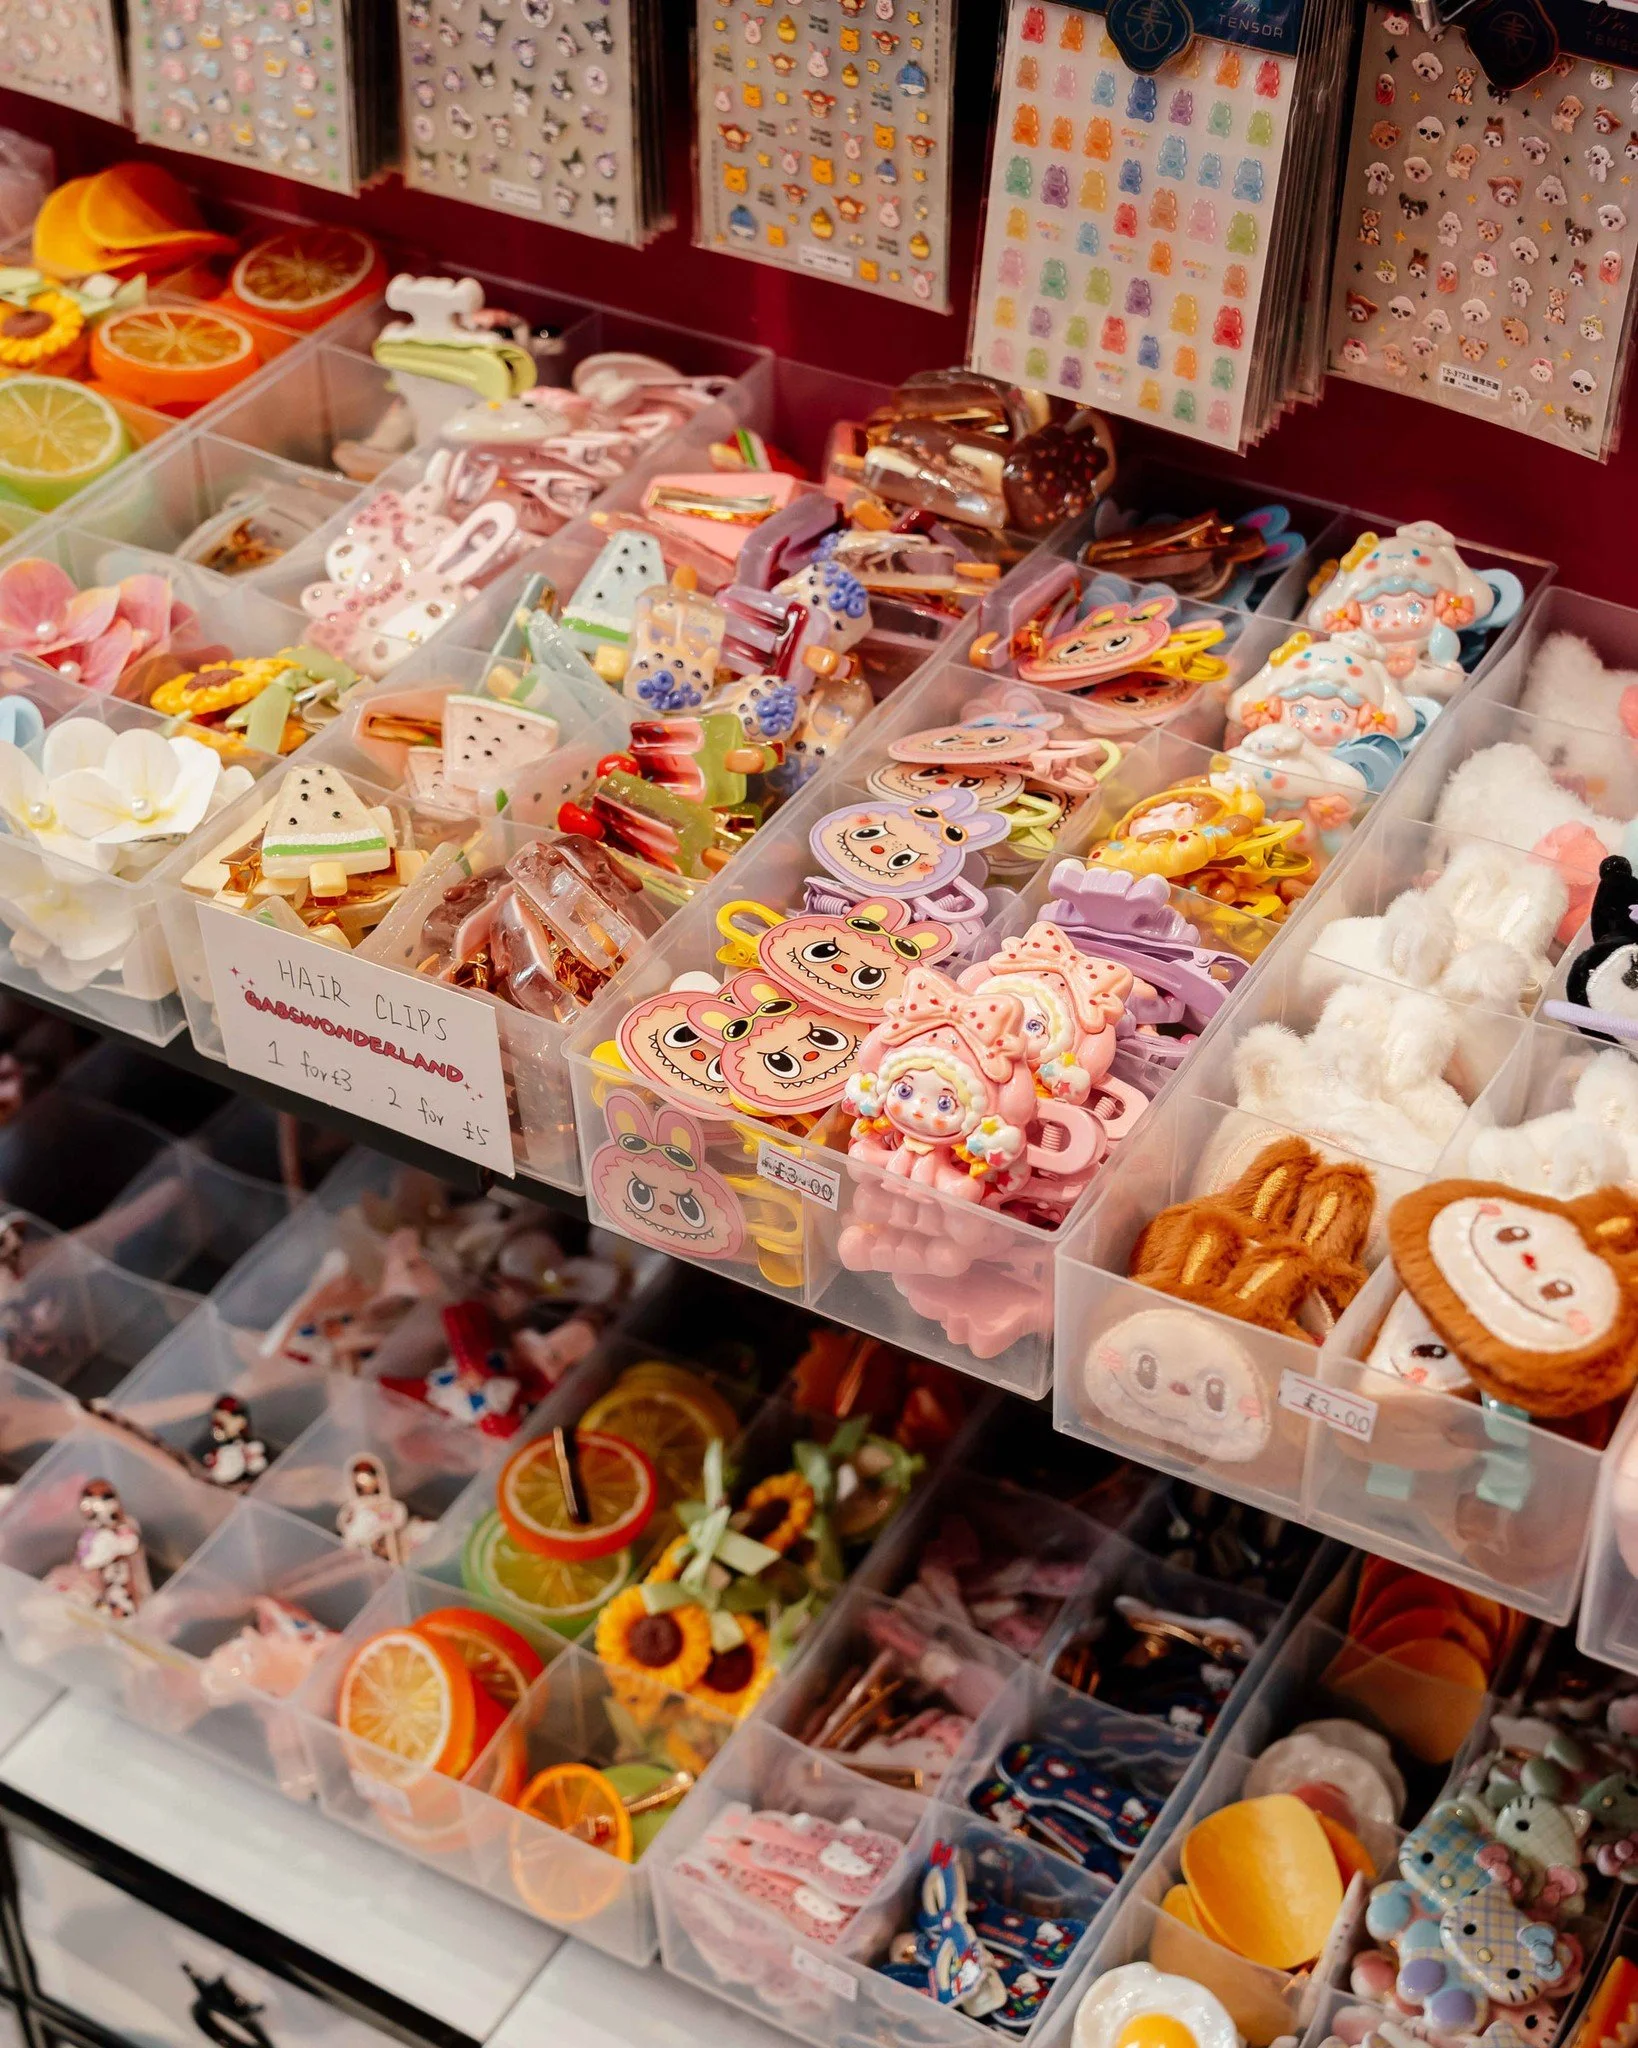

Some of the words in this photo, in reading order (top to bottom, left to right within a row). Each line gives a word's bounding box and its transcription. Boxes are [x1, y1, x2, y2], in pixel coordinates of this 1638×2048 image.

[1218, 14, 1284, 38] TENSOR
[276, 958, 351, 1008] HAIR
[375, 993, 448, 1041] CLIPS
[244, 989, 464, 1083] GABSWONDERLAND
[268, 1040, 285, 1066] 1
[387, 1086, 402, 1109] 2
[417, 1097, 444, 1127] for
[462, 1120, 490, 1146] £5
[774, 1161, 833, 1201] £3.00
[1303, 1392, 1370, 1434] £3.00
